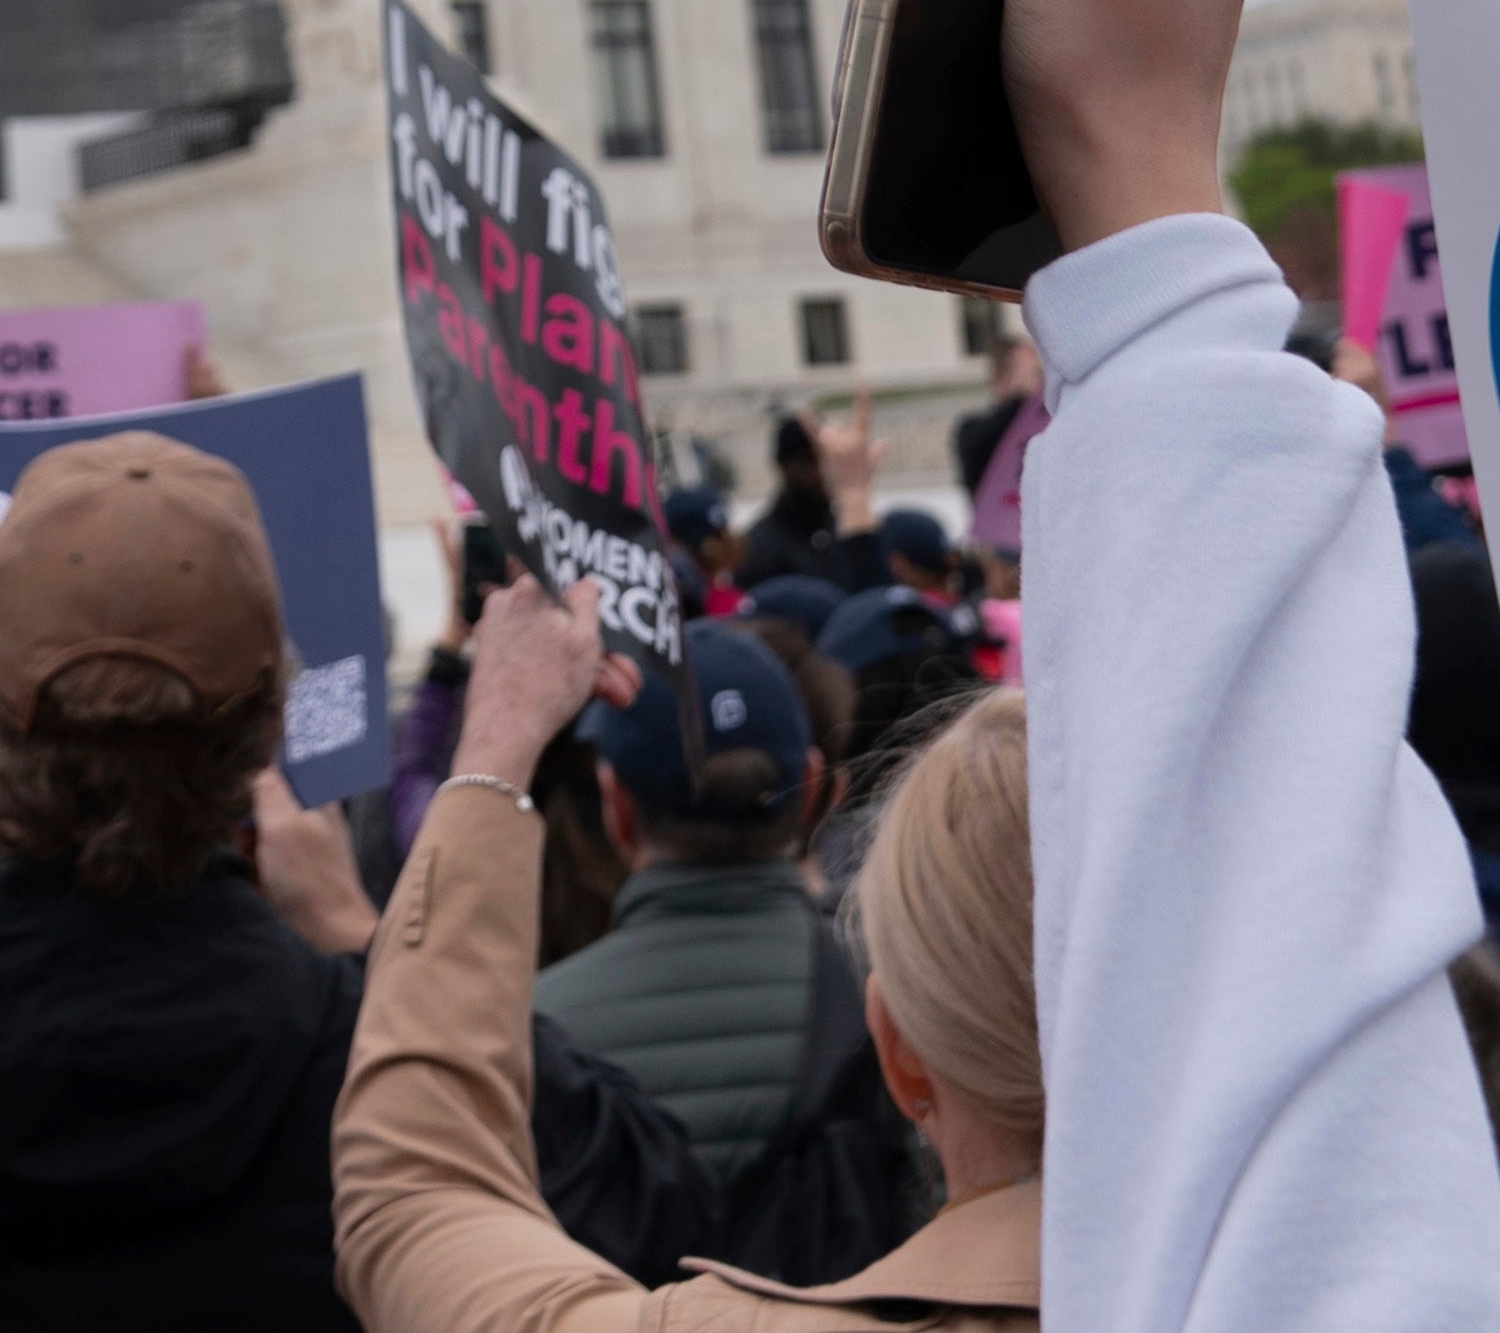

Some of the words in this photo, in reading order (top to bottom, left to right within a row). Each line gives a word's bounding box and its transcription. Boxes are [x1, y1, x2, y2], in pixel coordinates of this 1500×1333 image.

[387, 4, 409, 97] I
[417, 63, 521, 224] will
[392, 111, 469, 264] for
[402, 211, 668, 536] Parenth
